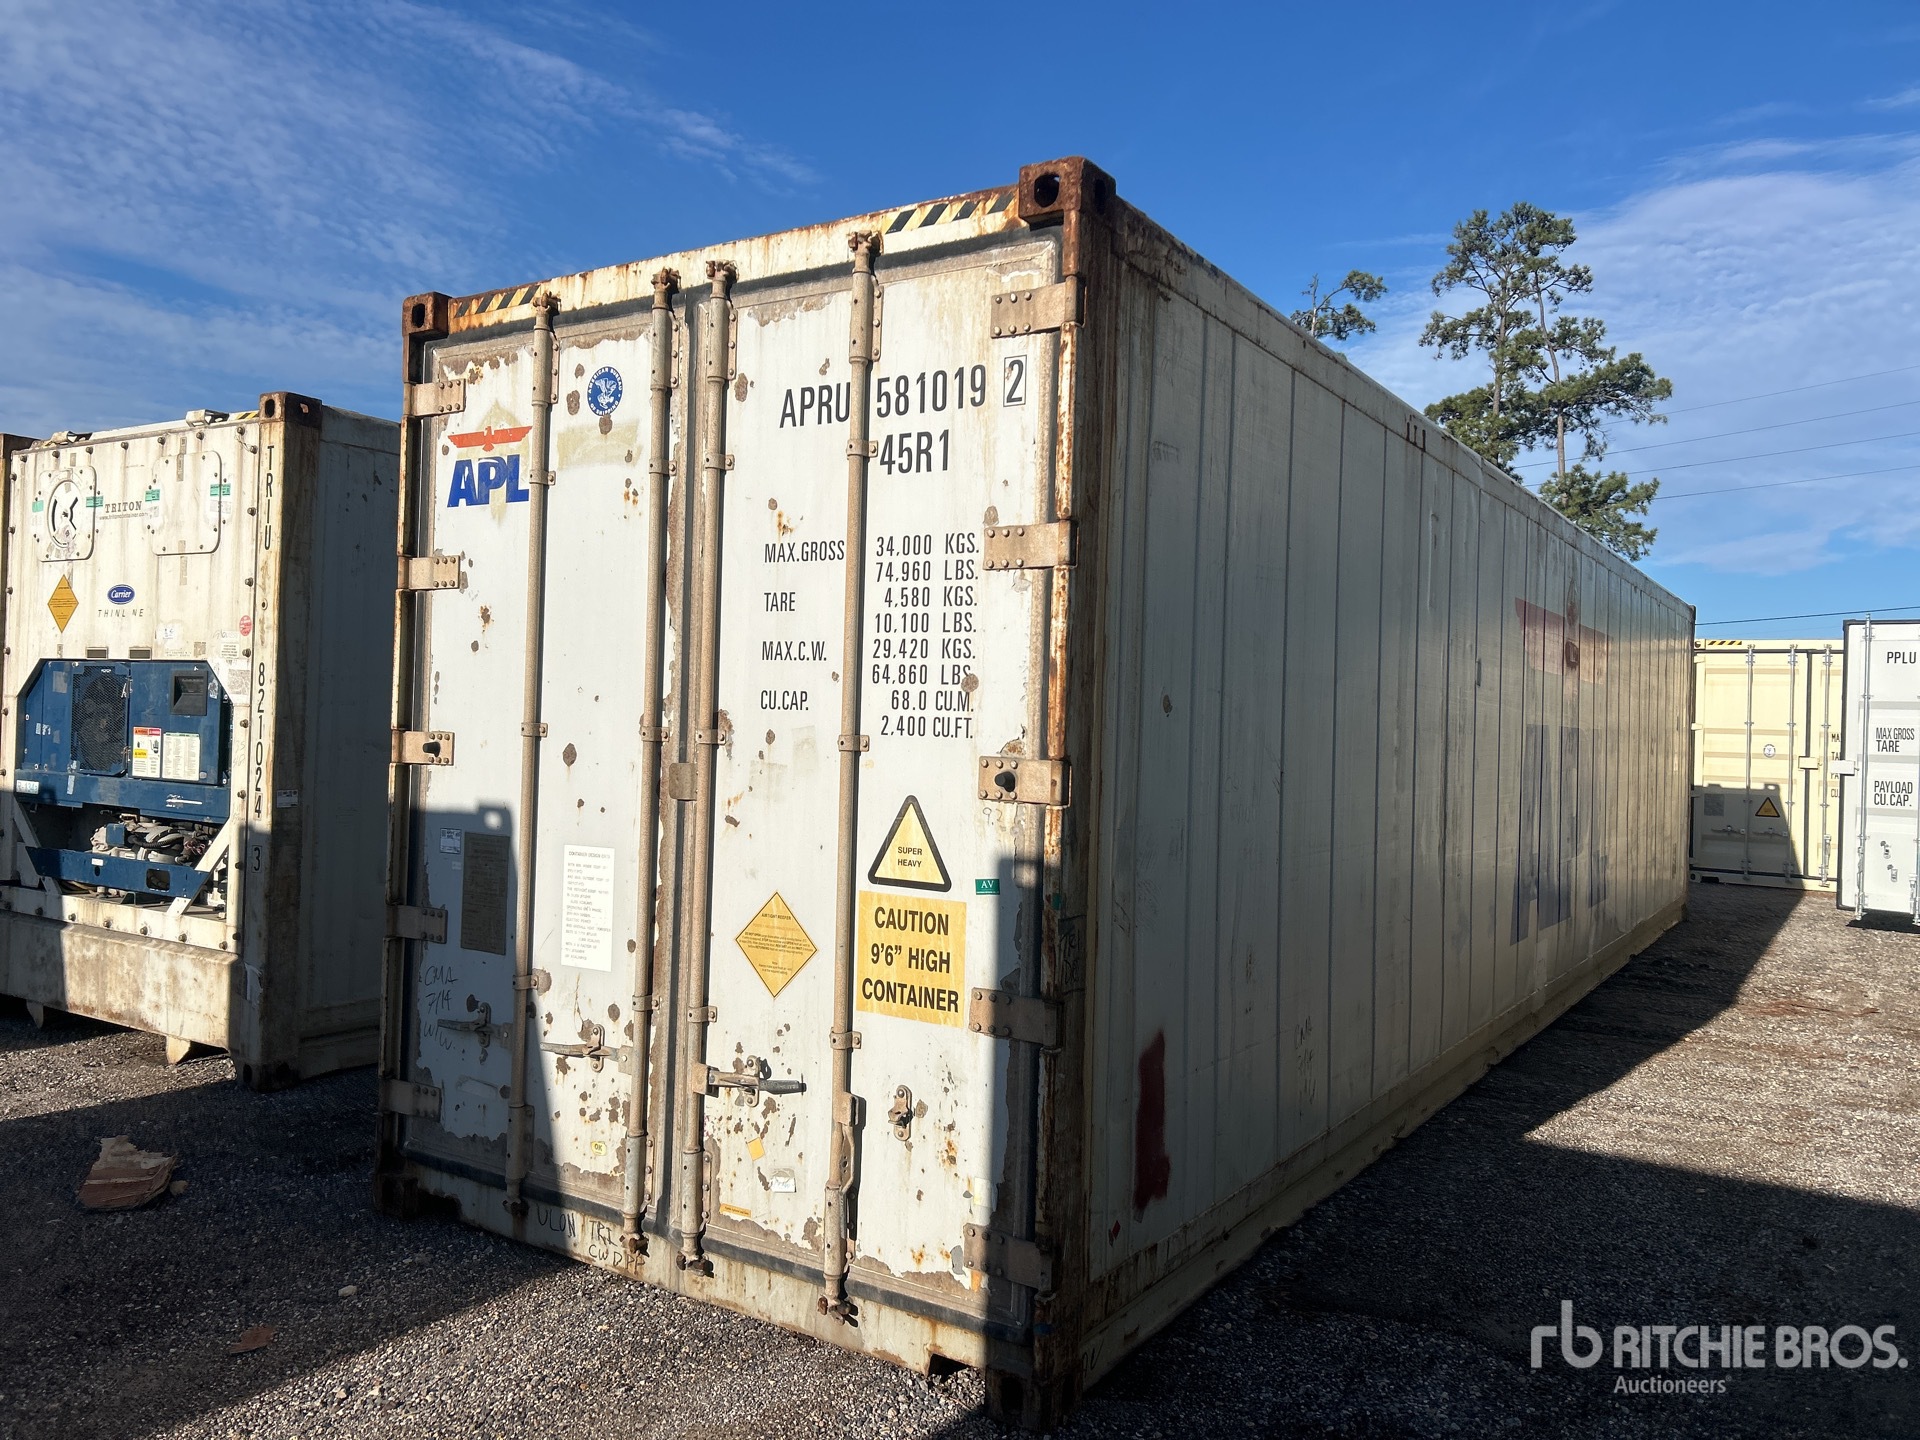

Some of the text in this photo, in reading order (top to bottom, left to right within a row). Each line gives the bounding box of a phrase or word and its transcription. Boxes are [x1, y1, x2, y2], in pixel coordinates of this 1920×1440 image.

[779, 359, 1025, 429] APRU 581019 2
[879, 429, 950, 475] 45R1
[446, 453, 529, 508] APL
[104, 500, 143, 513] TRITON
[264, 445, 274, 550] TRIU
[764, 540, 845, 563] MAX.GROSS
[944, 532, 980, 555] KGS.
[944, 559, 979, 581] LBS.
[110, 589, 132, 599] Carrier
[764, 592, 796, 612] TARE
[943, 585, 978, 607] KGS.
[97, 608, 144, 618] THINLNE
[942, 611, 977, 633] LBS.
[762, 641, 828, 662] MAX.C.W.
[941, 638, 976, 660] KGS.
[1886, 651, 1917, 664] PPLU
[941, 664, 973, 686] LBS
[760, 690, 809, 711] CU.CAP.
[891, 690, 927, 711] 68.0
[933, 716, 974, 739] CU.FT.
[1831, 733, 1840, 742] MA
[1875, 727, 1915, 740] MAX GROSS
[1876, 740, 1900, 753] TARE
[1874, 780, 1913, 794] PAYLOAD
[1873, 793, 1912, 807] CU.CAP.
[897, 846, 923, 856] SUPER
[897, 858, 922, 868] HEAVY
[981, 880, 994, 889] AV
[874, 906, 949, 936] CAUTION
[907, 947, 951, 974] HIGH
[861, 980, 959, 1013] CONTAINER
